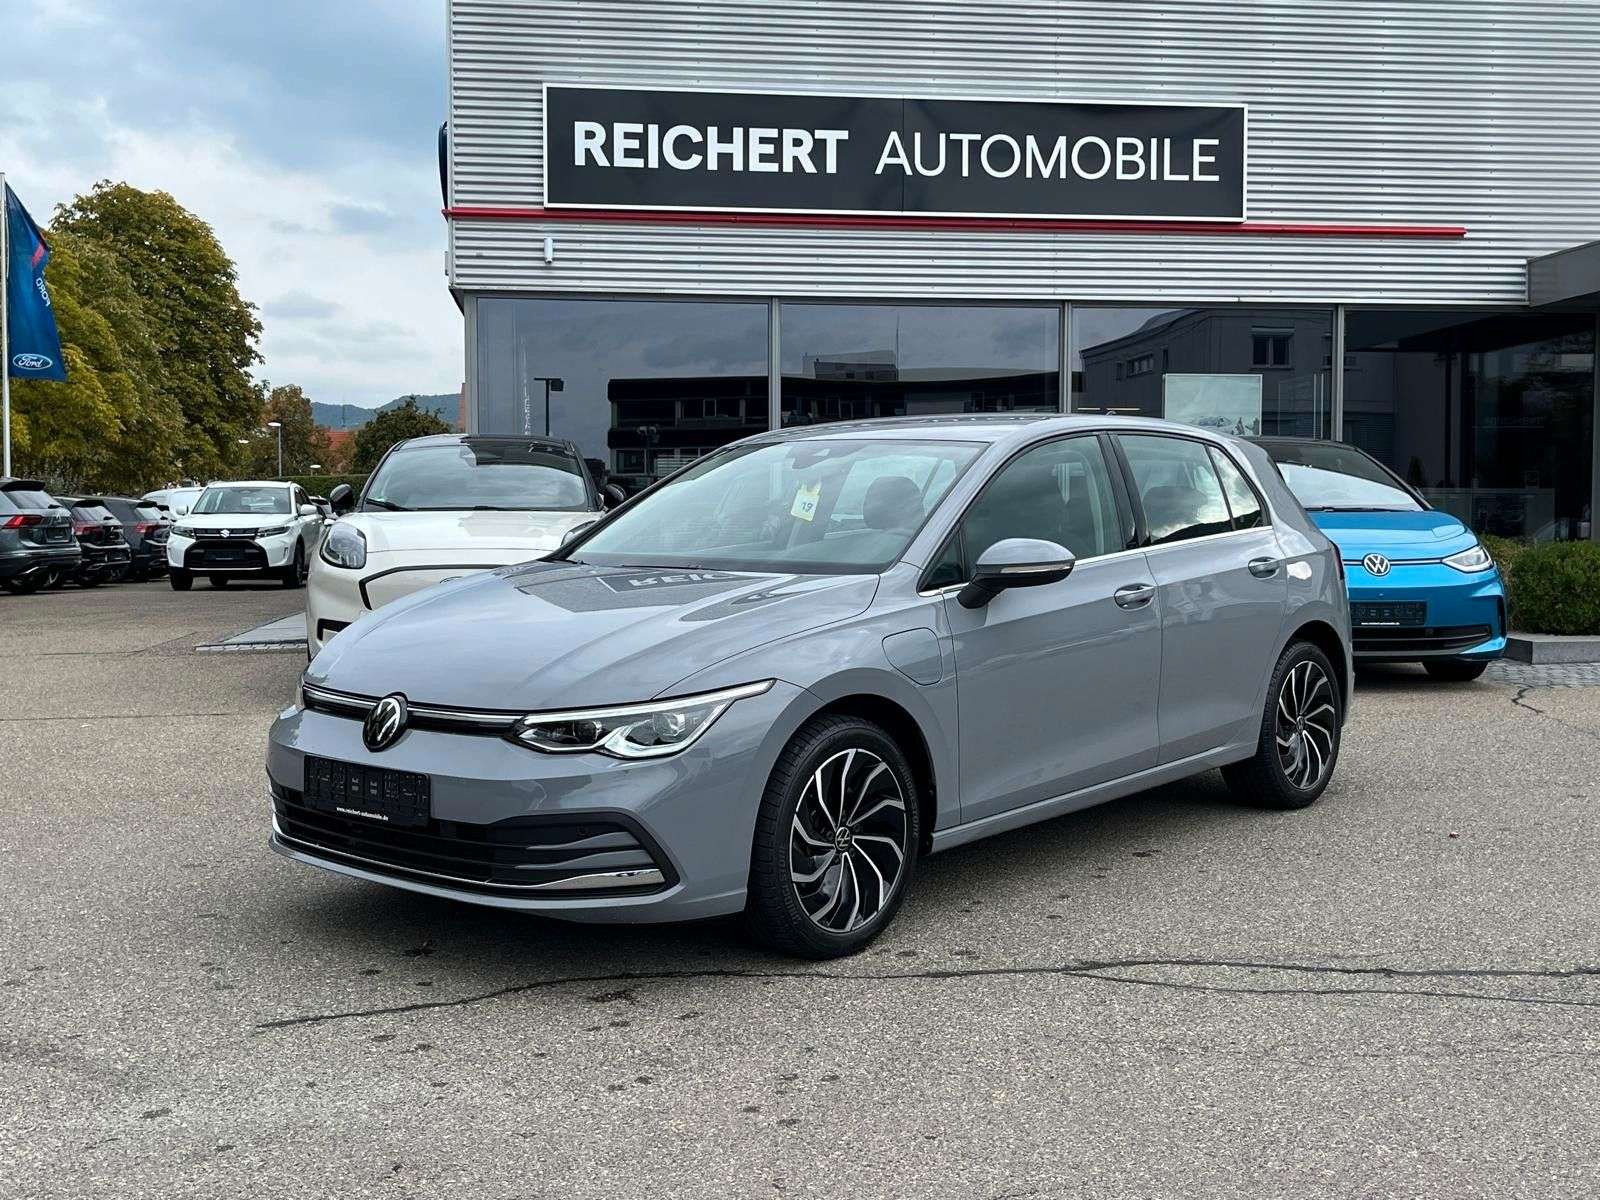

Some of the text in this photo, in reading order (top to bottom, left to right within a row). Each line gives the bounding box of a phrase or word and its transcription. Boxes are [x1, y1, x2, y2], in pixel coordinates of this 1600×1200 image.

[574, 121, 1219, 182] REICHERT AUTOMOBILE
[18, 355, 43, 368] Ford
